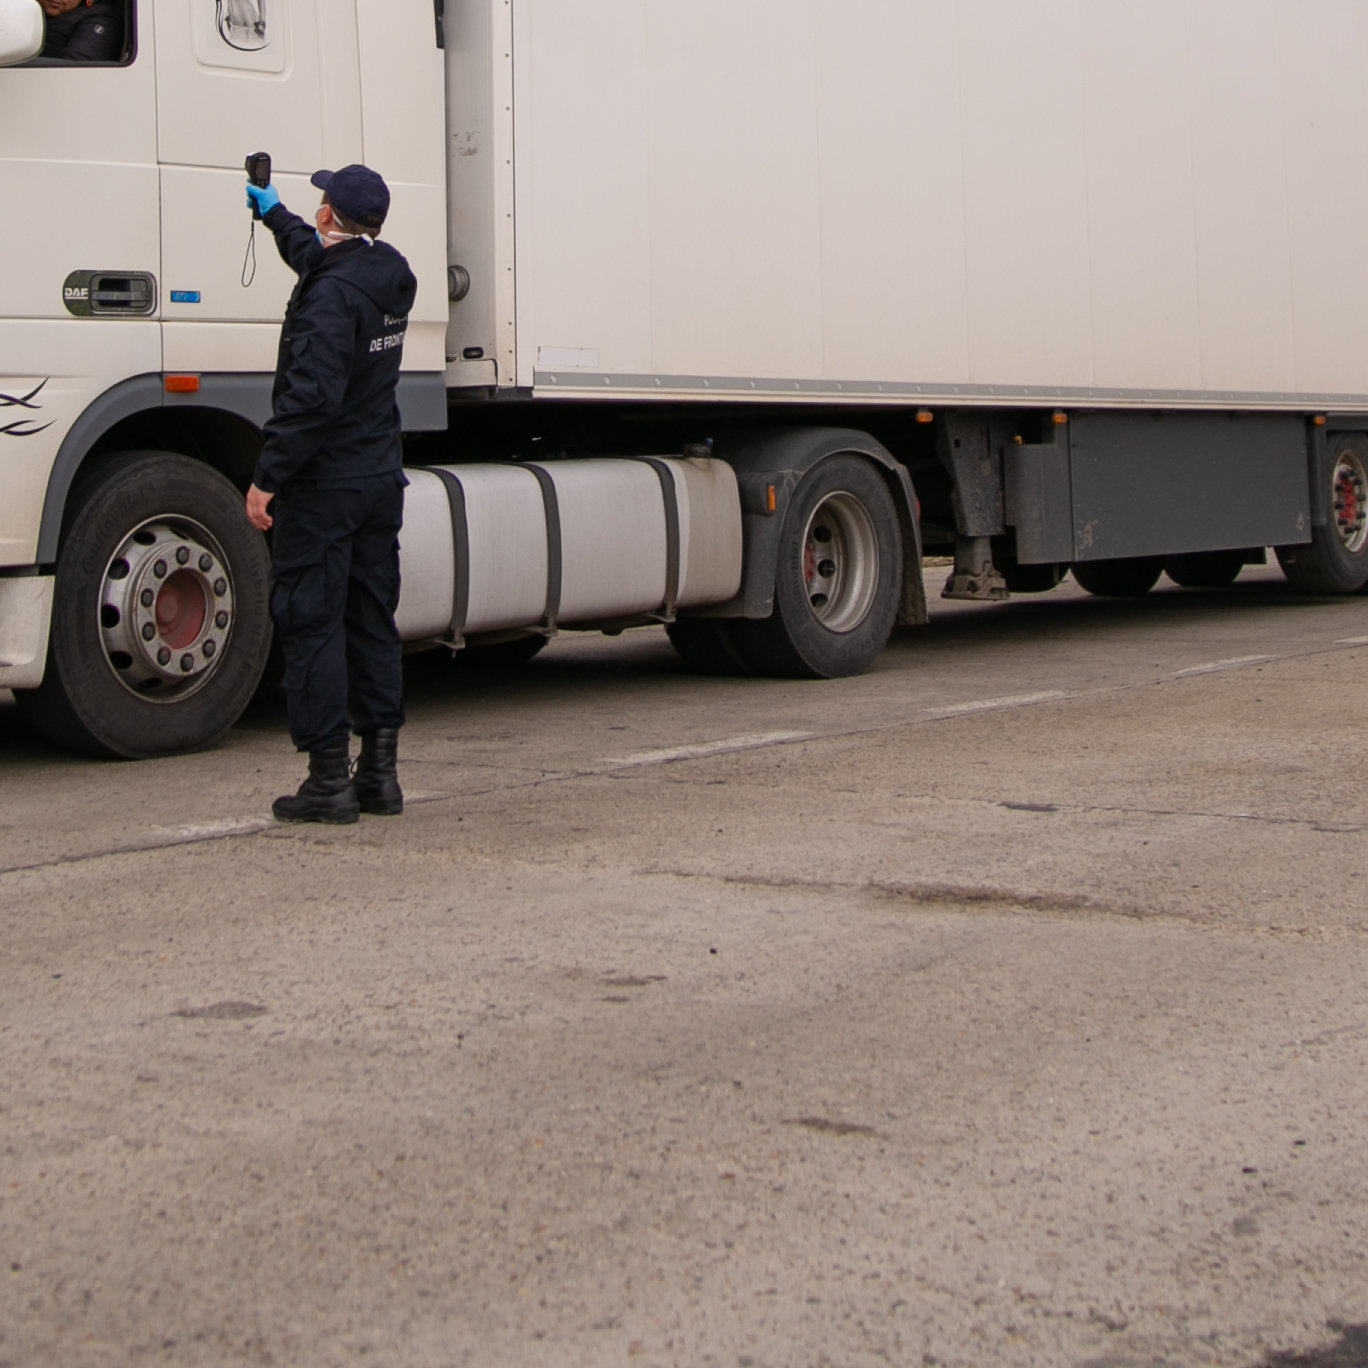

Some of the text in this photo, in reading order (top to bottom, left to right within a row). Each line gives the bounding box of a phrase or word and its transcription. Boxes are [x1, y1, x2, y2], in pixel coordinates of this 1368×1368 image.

[64, 287, 89, 297] DAF
[369, 332, 405, 352] DE FRONT
